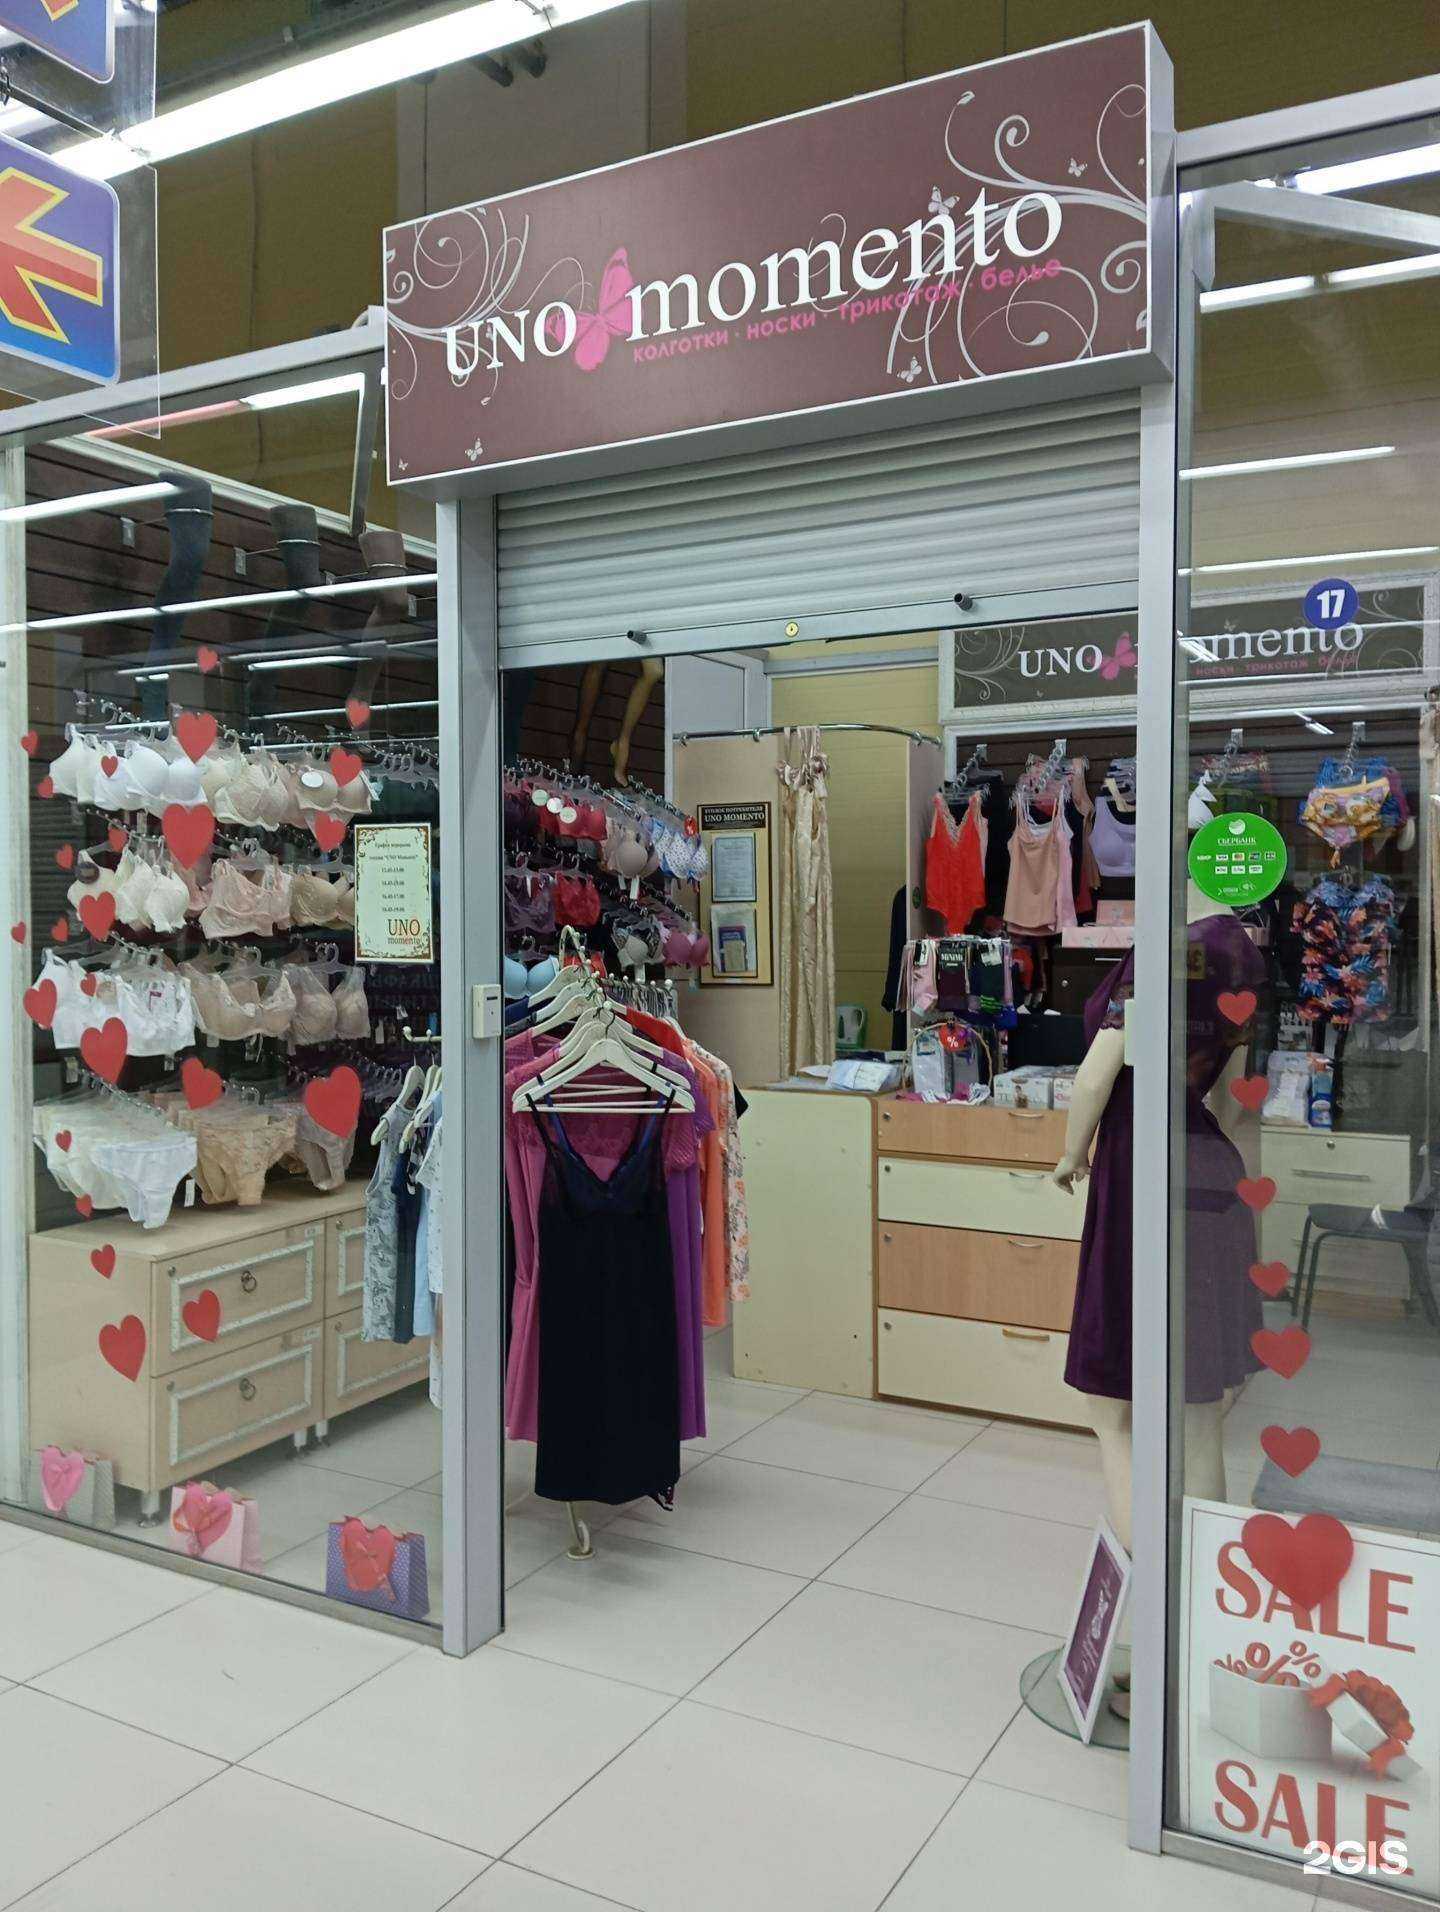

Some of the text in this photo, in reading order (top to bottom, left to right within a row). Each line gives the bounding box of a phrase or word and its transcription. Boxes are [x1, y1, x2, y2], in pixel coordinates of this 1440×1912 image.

[445, 187, 1063, 378] UNO momento
[633, 257, 1062, 364] колготки носки трикотаж белье
[1316, 588, 1346, 619] 17
[1018, 644, 1103, 678] UNO
[704, 812, 765, 822] UNO MOMENTO
[387, 919, 421, 936] UNO
[387, 937, 421, 945] momento
[1215, 1760, 1415, 1876] SALE
